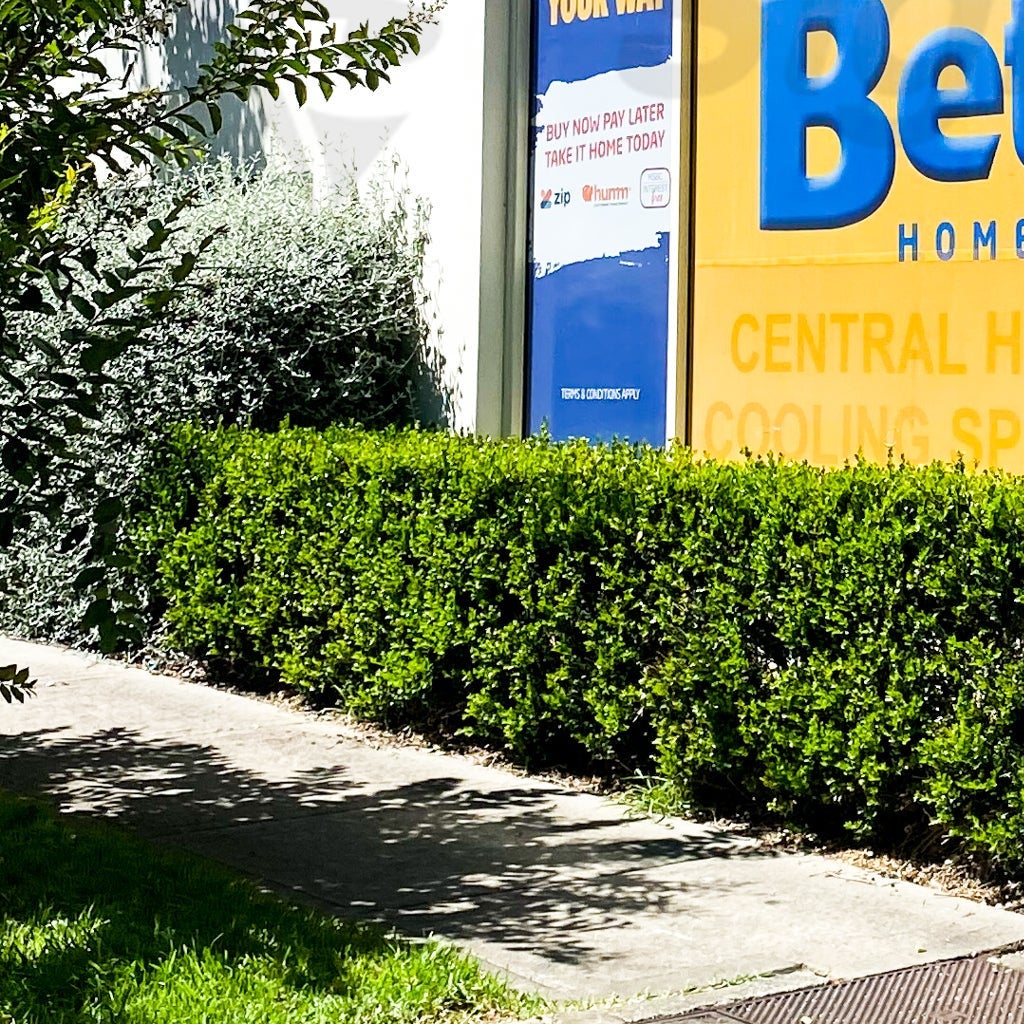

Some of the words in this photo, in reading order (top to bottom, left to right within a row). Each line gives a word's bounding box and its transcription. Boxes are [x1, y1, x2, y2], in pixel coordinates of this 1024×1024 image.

[546, 120, 570, 142] BUY
[573, 113, 600, 136] NOW
[603, 109, 626, 130] PAY
[629, 102, 665, 125] LATER
[545, 146, 572, 168] TAKE
[575, 144, 587, 163] IT
[589, 137, 623, 160] HOME
[627, 130, 666, 153] TODAY
[554, 187, 571, 207] zip
[594, 184, 629, 201] humm
[730, 313, 967, 375] CENTRAL
[704, 401, 930, 465] COOLING
